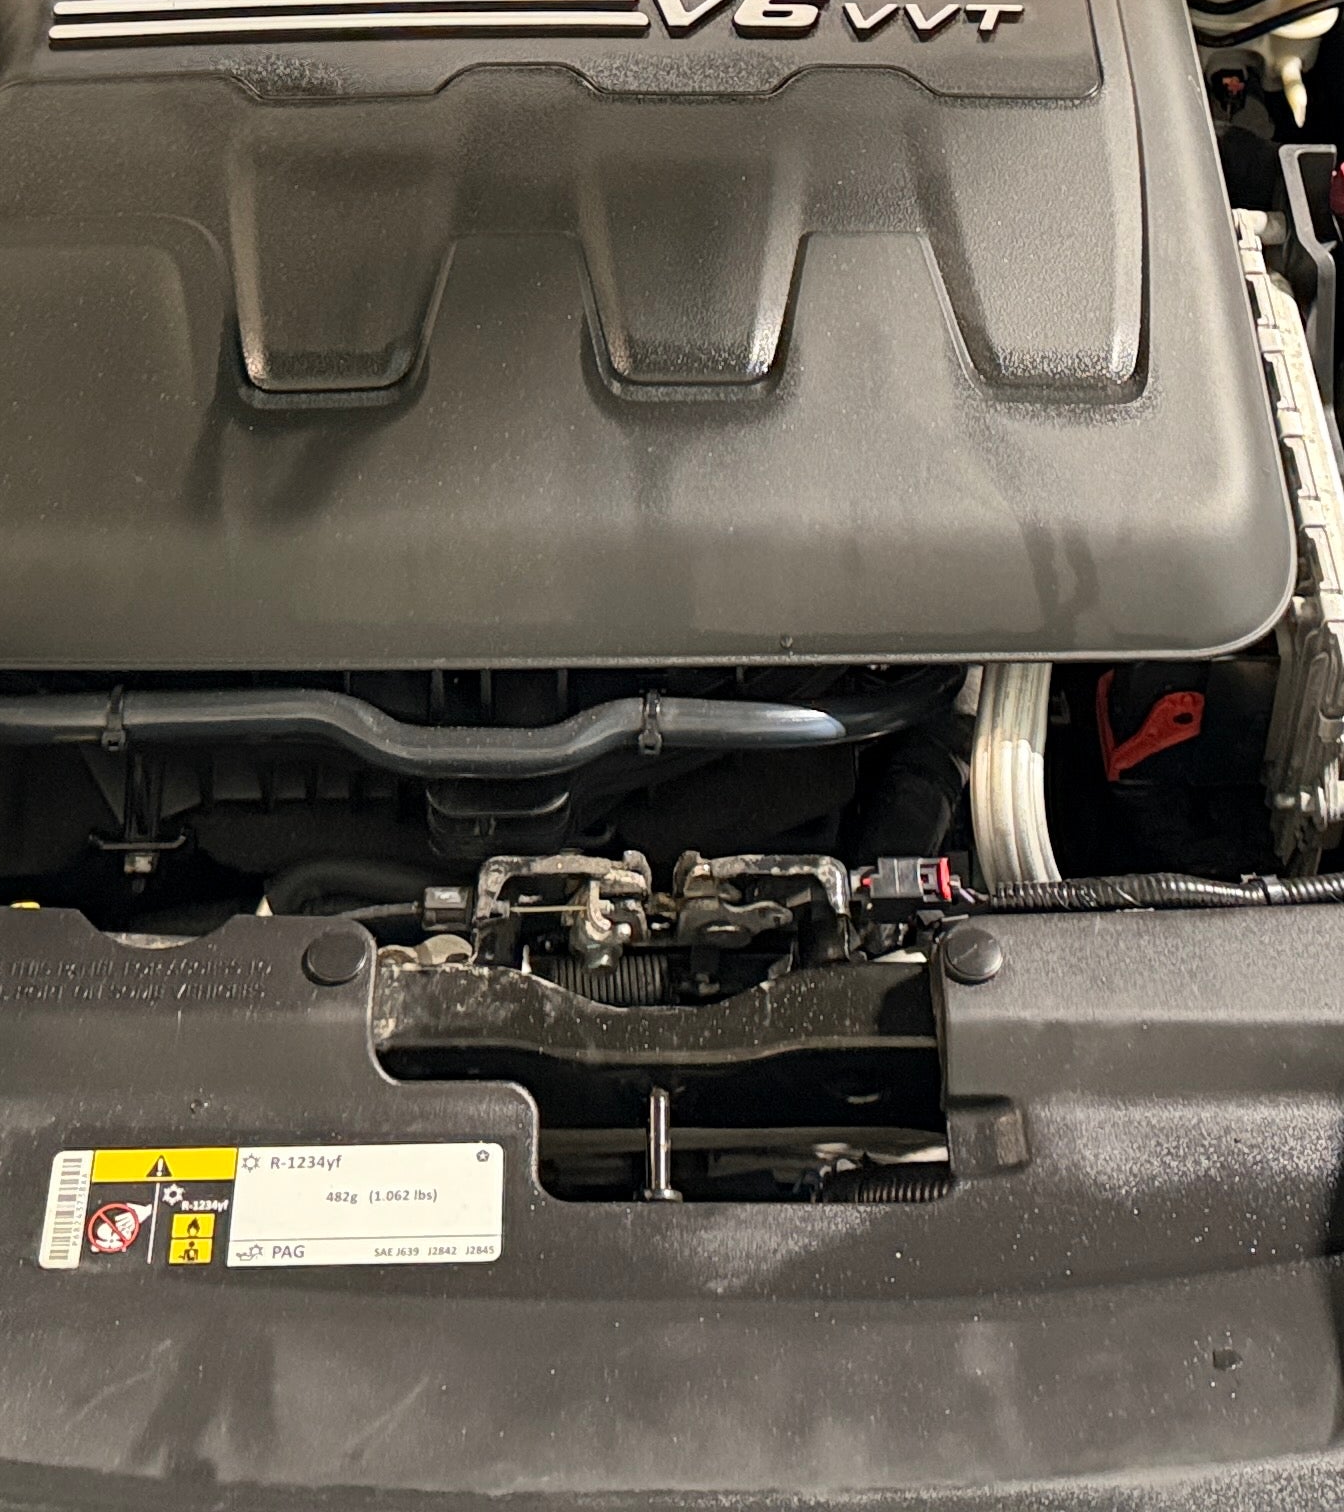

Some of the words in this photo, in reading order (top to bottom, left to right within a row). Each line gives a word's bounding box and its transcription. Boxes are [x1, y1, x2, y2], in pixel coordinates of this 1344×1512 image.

[842, 2, 1024, 37] VVT
[270, 1154, 342, 1172] R-1234yf
[326, 1191, 358, 1205] 482g
[369, 1189, 410, 1204] (1.062
[413, 1188, 438, 1203] lbs)
[181, 1199, 230, 1213] R-1234yf
[271, 1244, 306, 1259] PAG
[374, 1247, 393, 1257] SAE
[396, 1247, 419, 1257] J639
[427, 1246, 457, 1256] J2842
[465, 1245, 495, 1255] J2845
